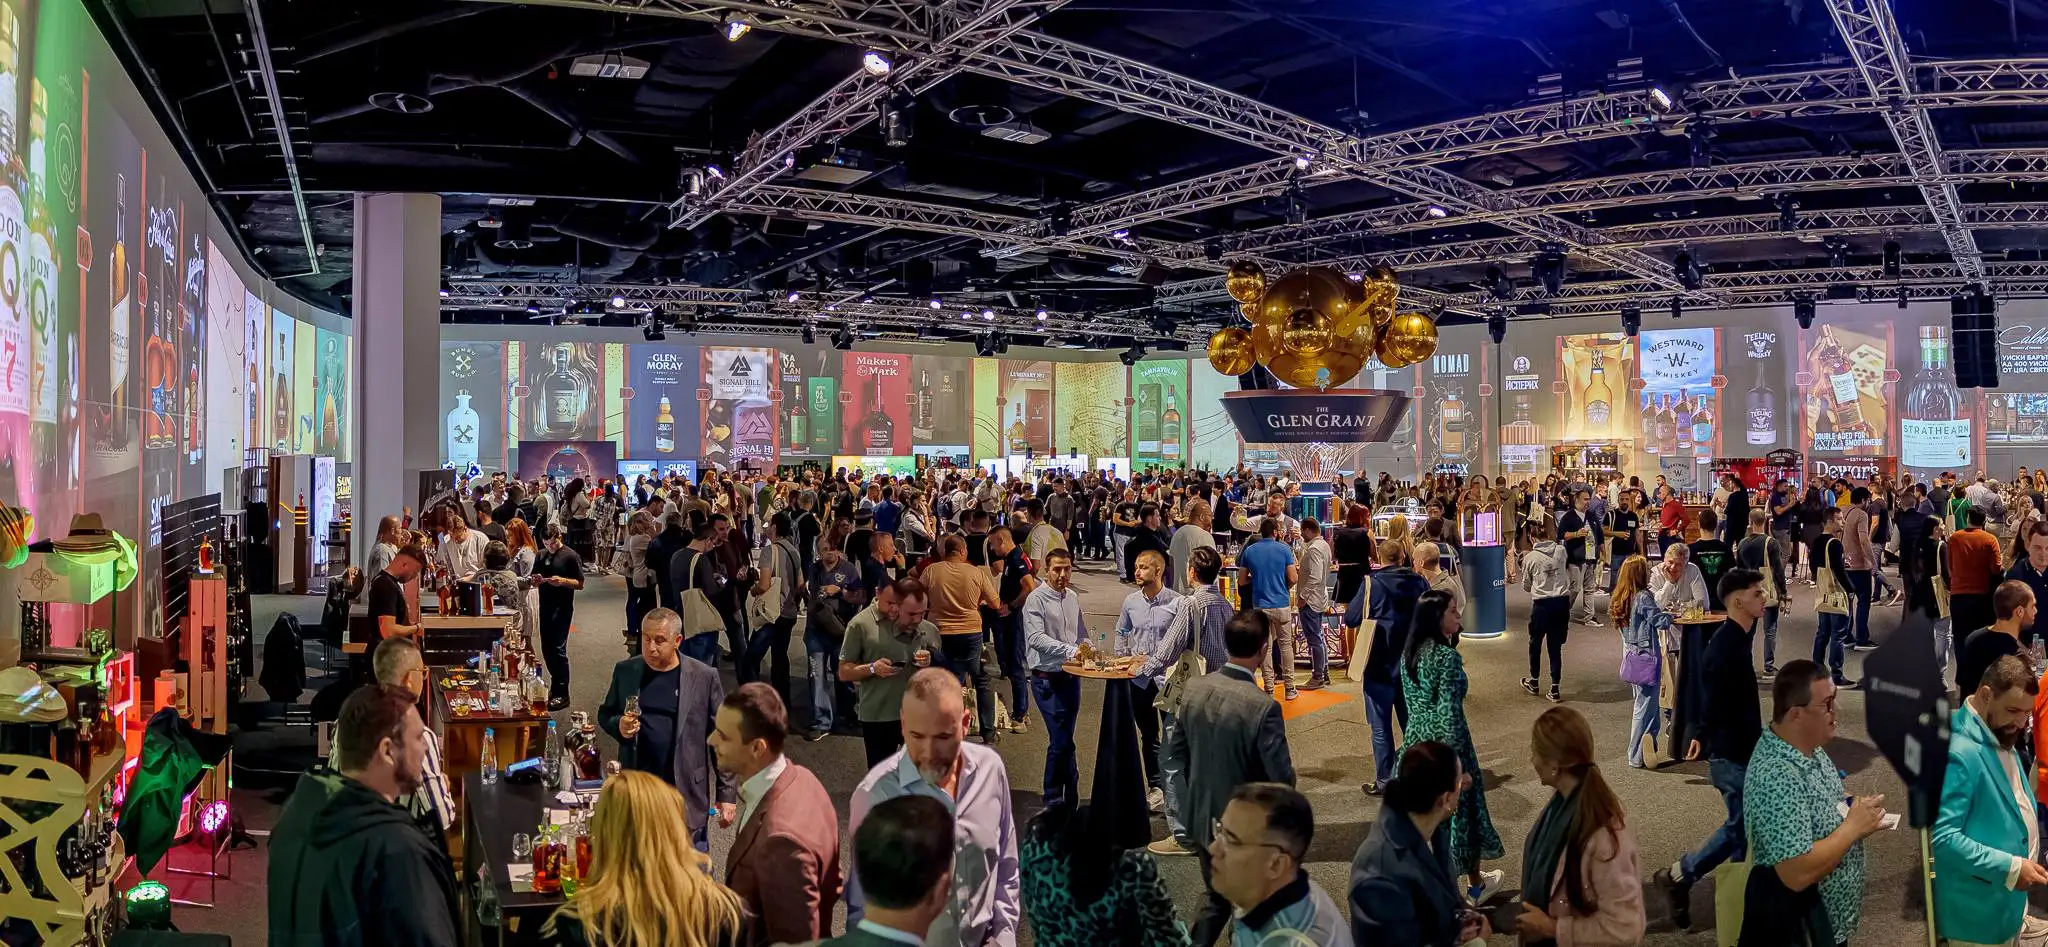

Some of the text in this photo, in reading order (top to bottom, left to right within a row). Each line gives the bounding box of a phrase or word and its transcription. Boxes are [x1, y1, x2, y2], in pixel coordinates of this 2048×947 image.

[1744, 332, 1776, 344] TEELING
[1648, 340, 1705, 354] WESTWARD
[652, 353, 677, 362] GLEN
[856, 356, 899, 366] Maker's
[646, 361, 684, 370] MORAY
[1433, 353, 1470, 374] NOMAD
[783, 367, 801, 375] LAN
[869, 366, 899, 376] Mark
[1655, 369, 1699, 379] WHISKEY
[719, 378, 761, 386] SIGNAL HILL
[1504, 380, 1539, 391] ИСПЕРИХ
[1903, 424, 1969, 435] STRATHEARN
[728, 444, 762, 457] SIGNAL
[668, 463, 687, 471] GLEN
[1815, 461, 1880, 479] Dewar's
